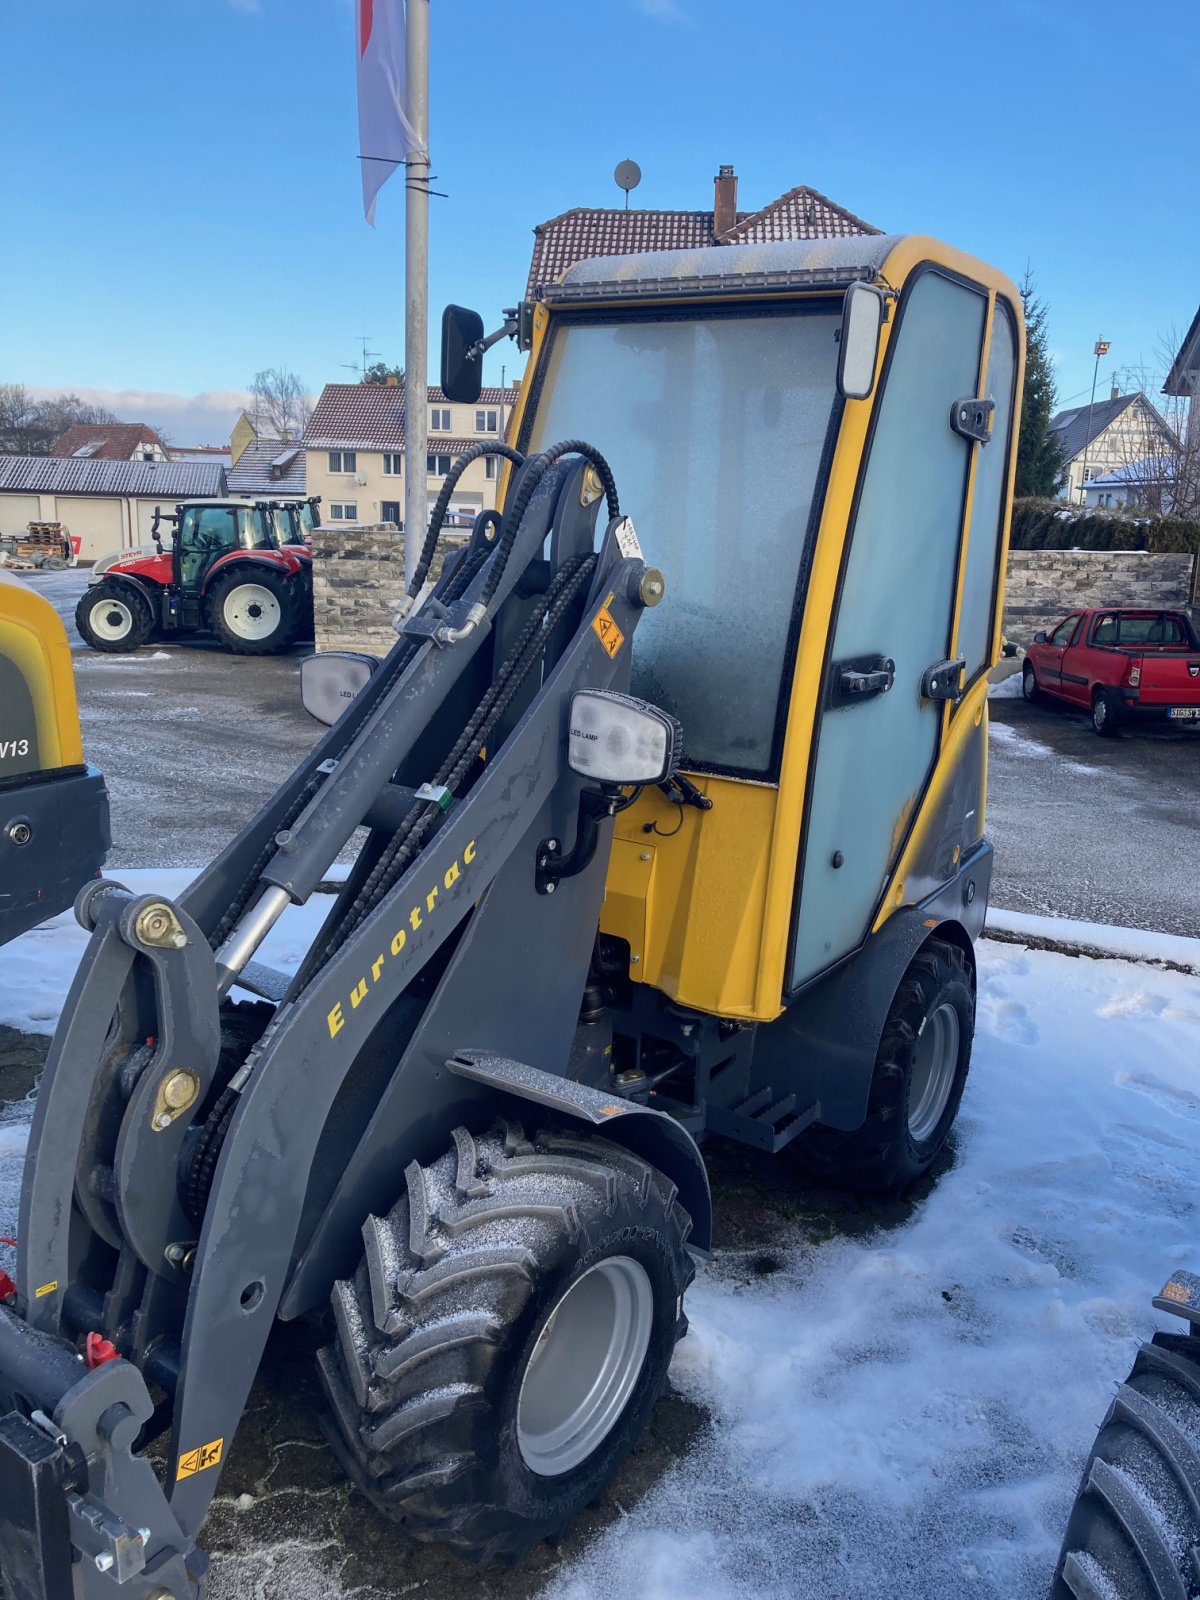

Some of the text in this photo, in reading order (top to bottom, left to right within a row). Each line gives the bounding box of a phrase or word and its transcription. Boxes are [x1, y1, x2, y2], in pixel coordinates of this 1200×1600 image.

[120, 551, 143, 559] STEYR
[571, 729, 598, 741] LED LAMP
[327, 840, 477, 1039] Eurotrac
